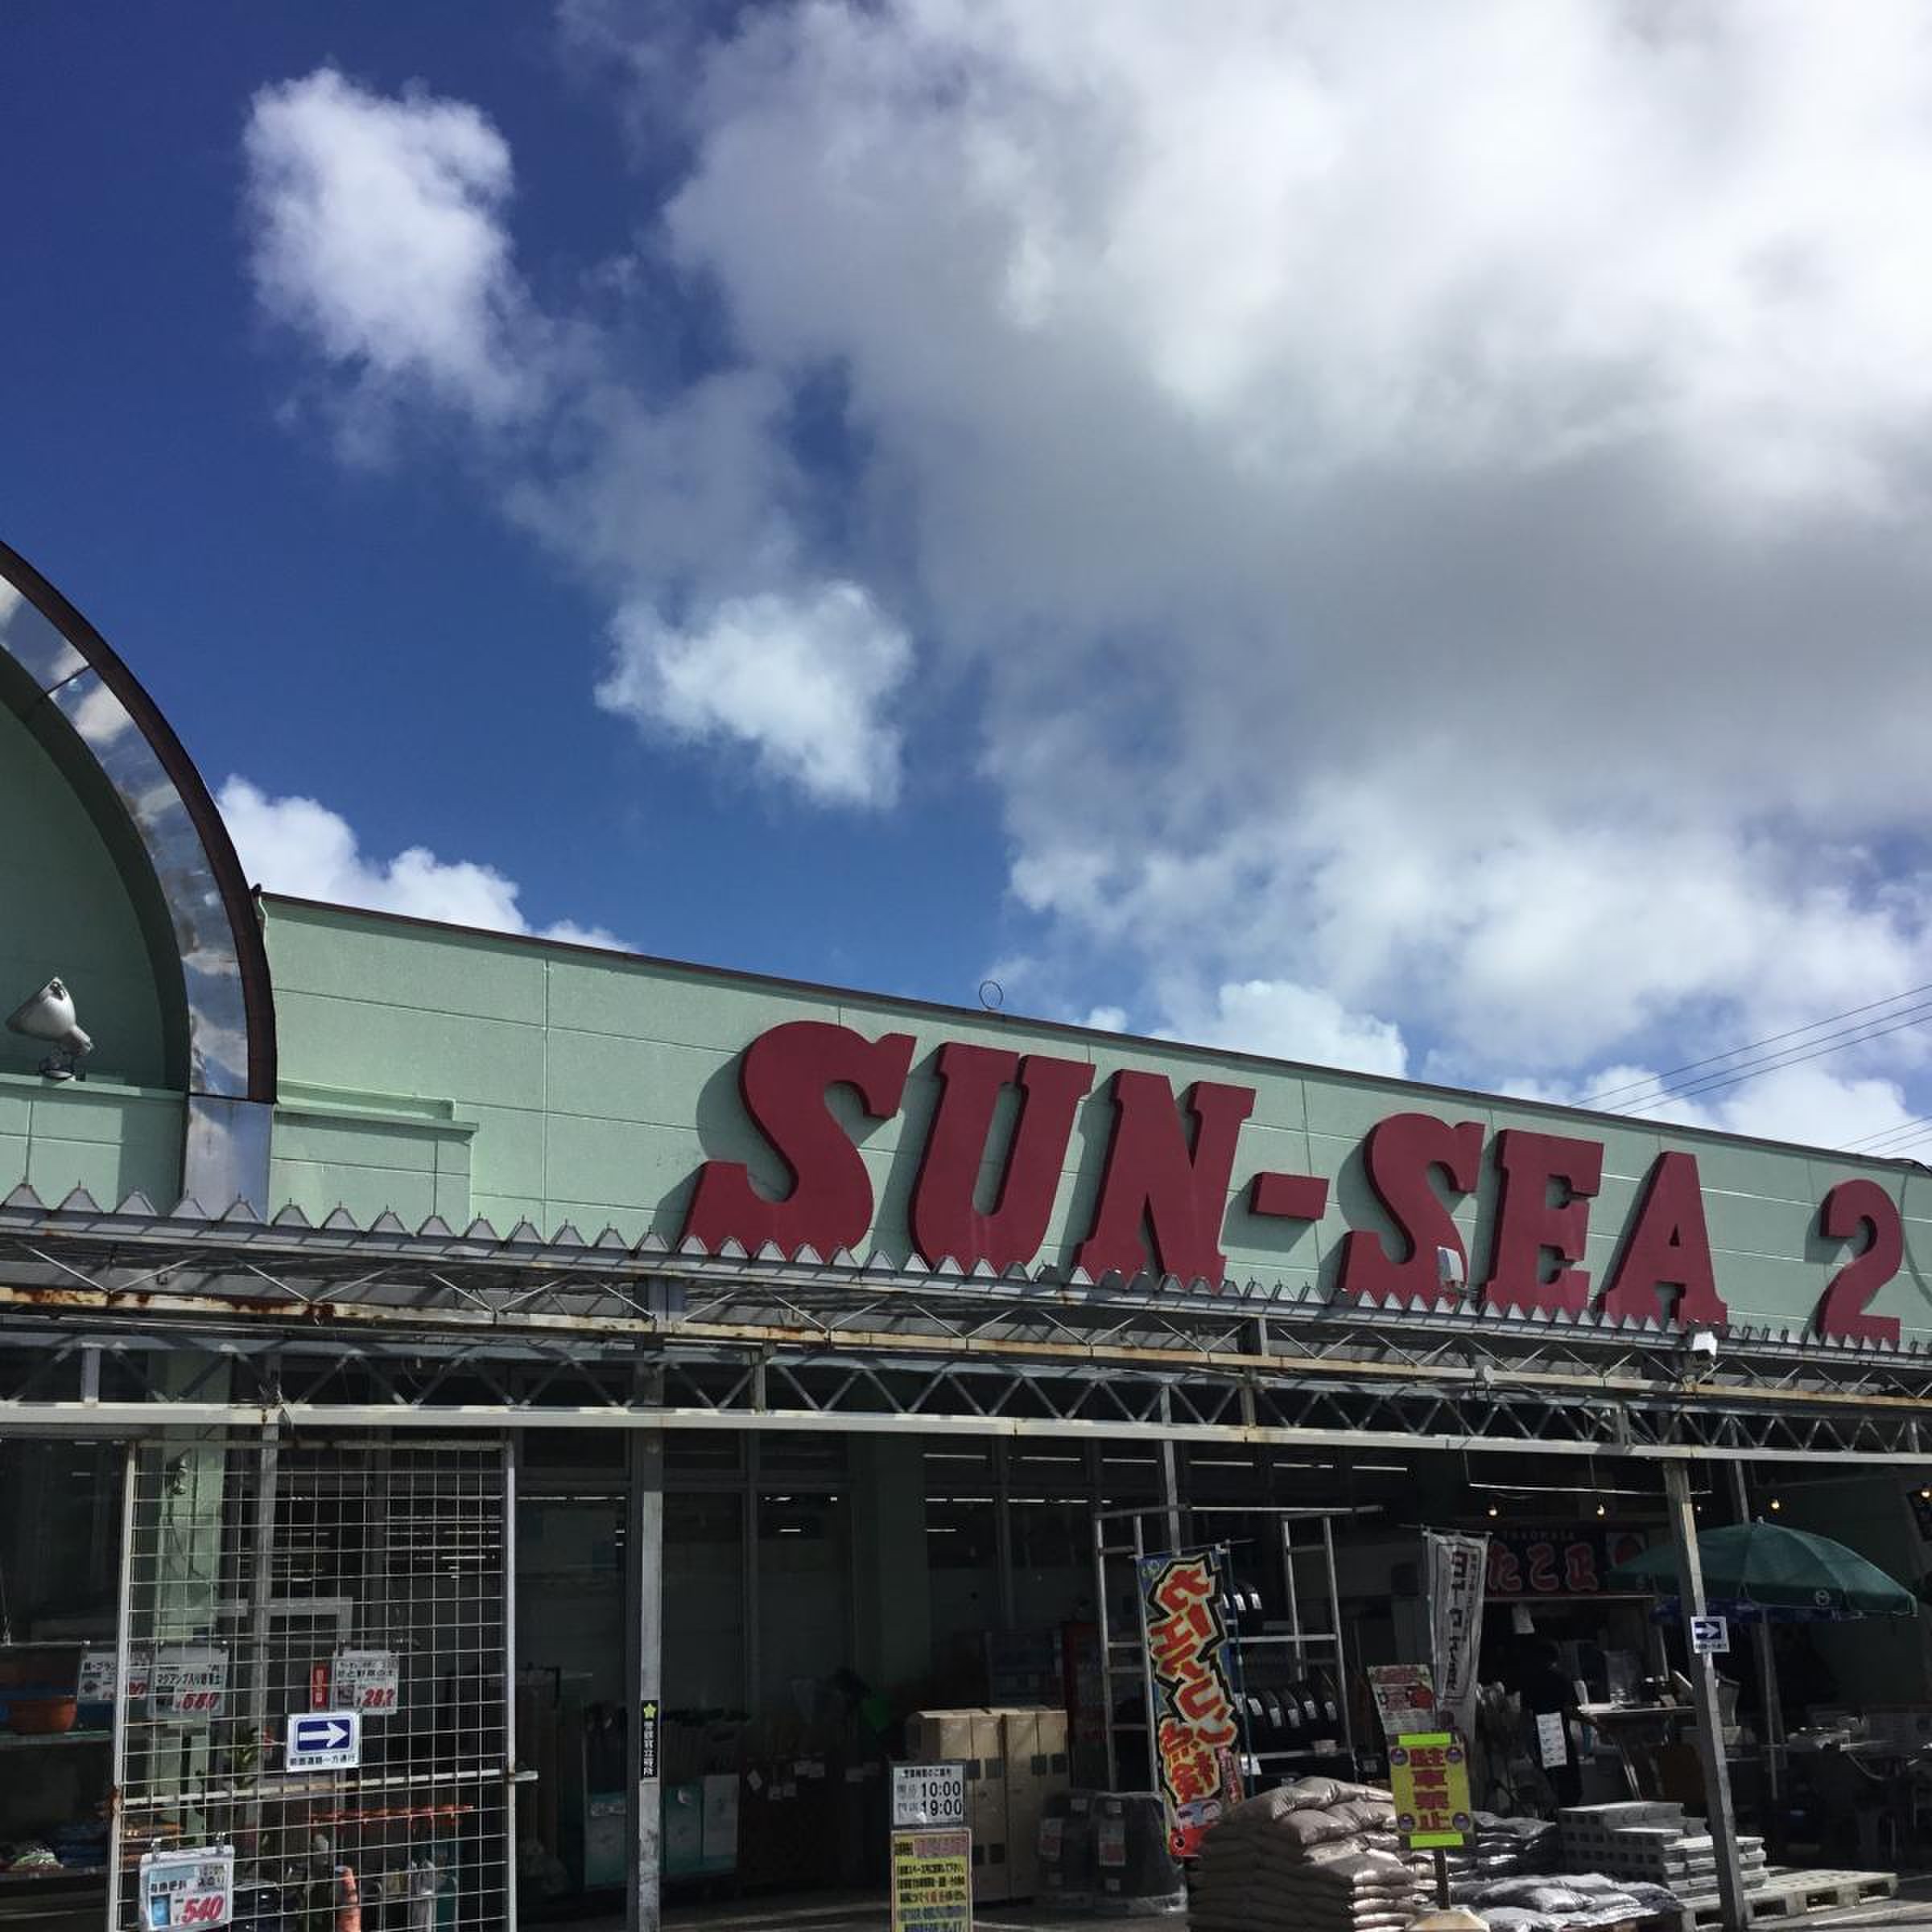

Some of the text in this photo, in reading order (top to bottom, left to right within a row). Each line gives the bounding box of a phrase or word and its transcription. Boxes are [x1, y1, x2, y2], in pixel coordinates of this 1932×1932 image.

[682, 1021, 1902, 1340] SUN-SEA 2
[922, 1781, 961, 1798] 10:00
[922, 1799, 962, 1816] 19:00
[181, 1894, 225, 1923] 540
